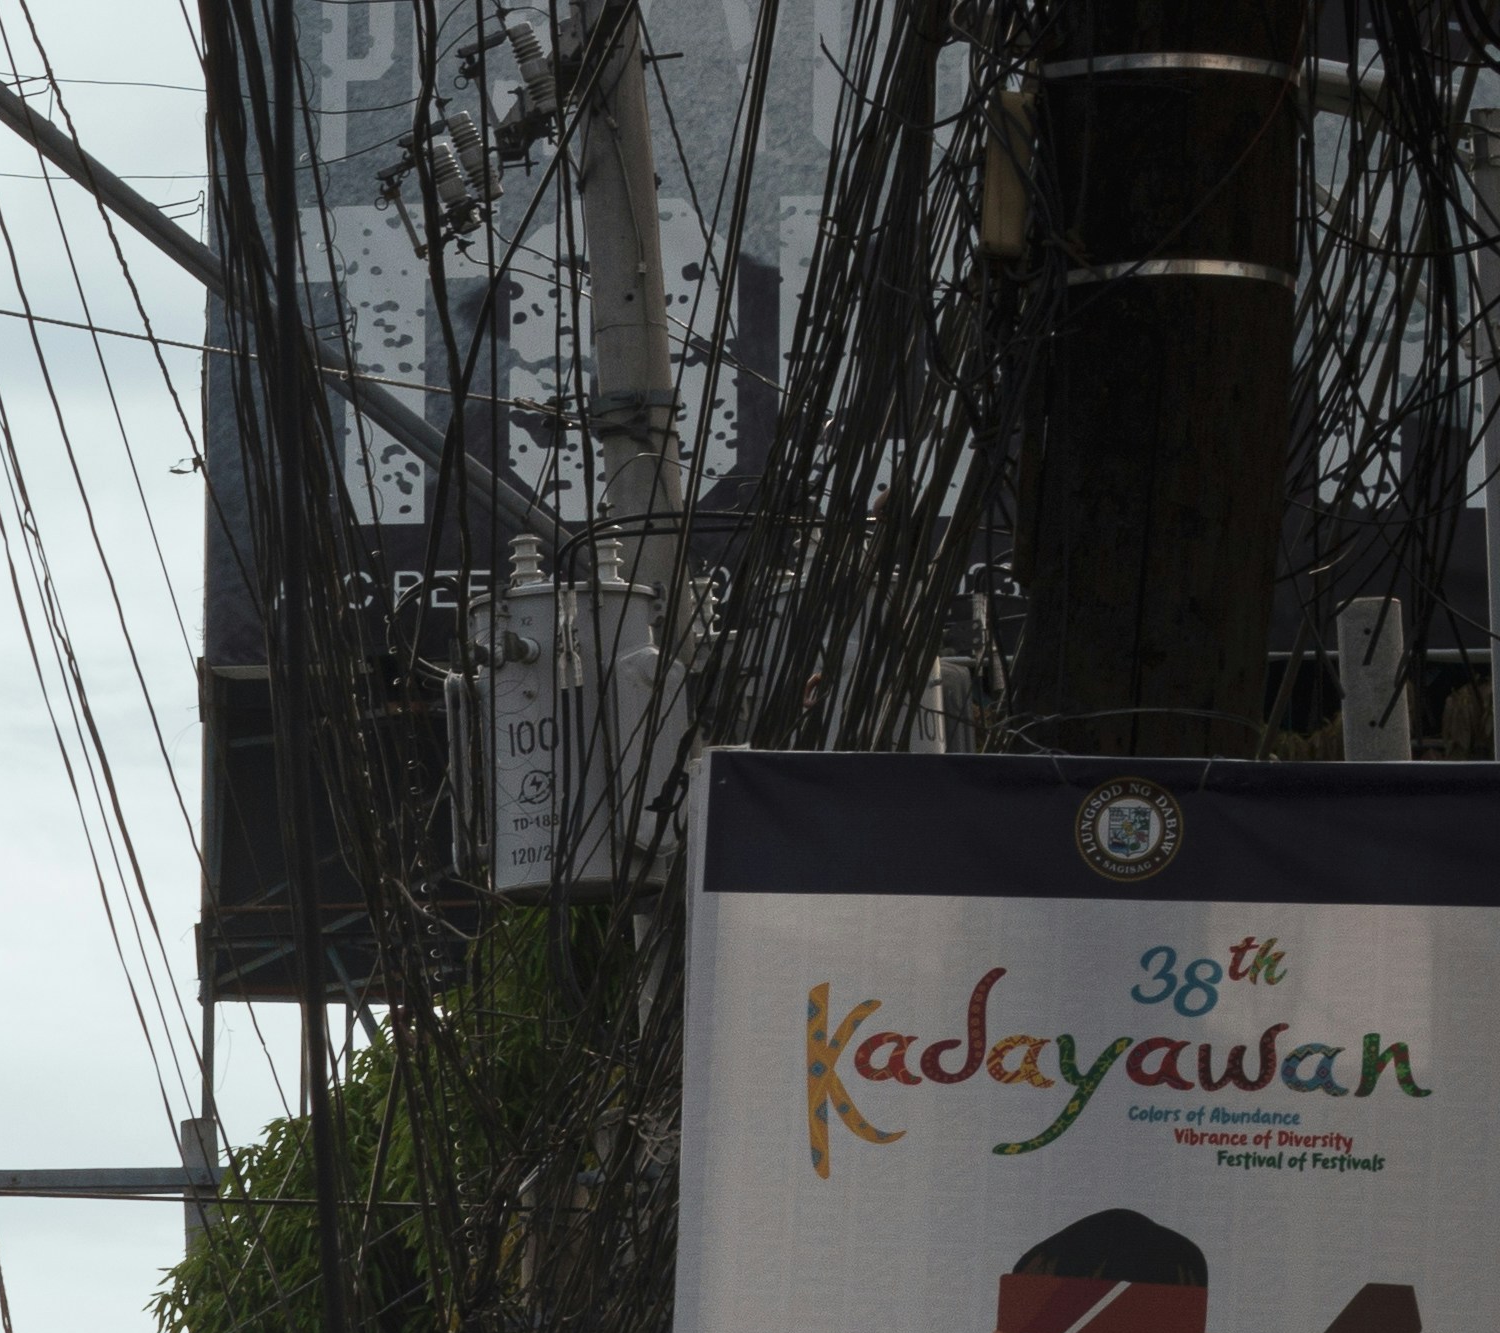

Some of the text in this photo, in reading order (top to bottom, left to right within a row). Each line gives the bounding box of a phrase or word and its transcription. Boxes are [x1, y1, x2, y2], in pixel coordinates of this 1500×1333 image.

[509, 717, 558, 757] 100
[1080, 783, 1178, 856] LUNGSOD NG DABAW
[1129, 937, 1288, 1018] 38th
[806, 967, 1433, 1181] Kadayawan
[1128, 1105, 1301, 1126] Colors of Abundance
[1173, 1127, 1354, 1154] Vibrance of Diversity
[1216, 1150, 1386, 1174] Festival of Festivals
